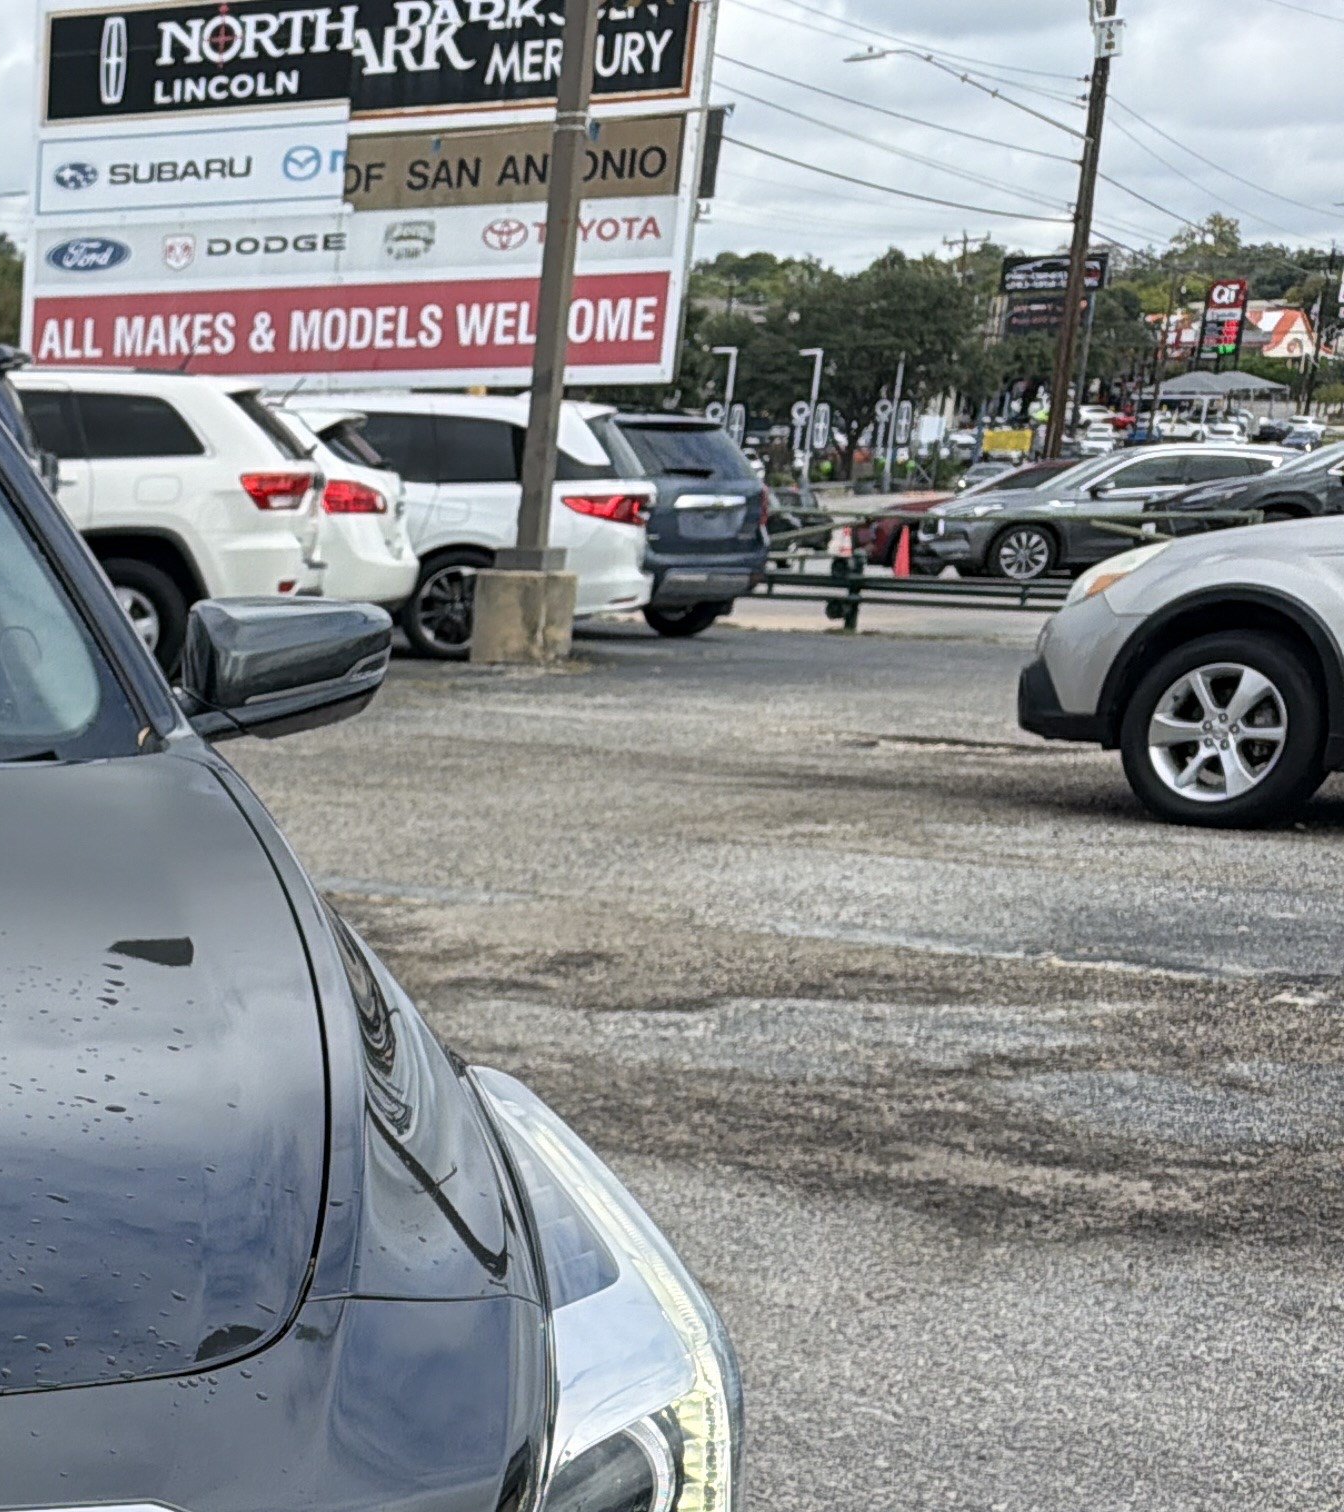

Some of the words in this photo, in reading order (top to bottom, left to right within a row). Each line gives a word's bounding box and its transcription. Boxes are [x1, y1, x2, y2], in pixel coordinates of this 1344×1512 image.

[156, 5, 359, 66] NORTH
[484, 29, 673, 85] MERURY
[154, 69, 299, 104] LINCOLN
[108, 156, 252, 185] SUBARU
[407, 157, 481, 191] SAN
[498, 146, 667, 185] ANONIO
[207, 233, 347, 256] DODGE
[533, 216, 661, 243] TYOTA
[1212, 284, 1240, 304] QT
[38, 317, 103, 360] ALL
[113, 312, 236, 358] MAKES
[249, 311, 276, 353] &
[289, 304, 443, 352] MODELS
[456, 296, 658, 346] WELOME
